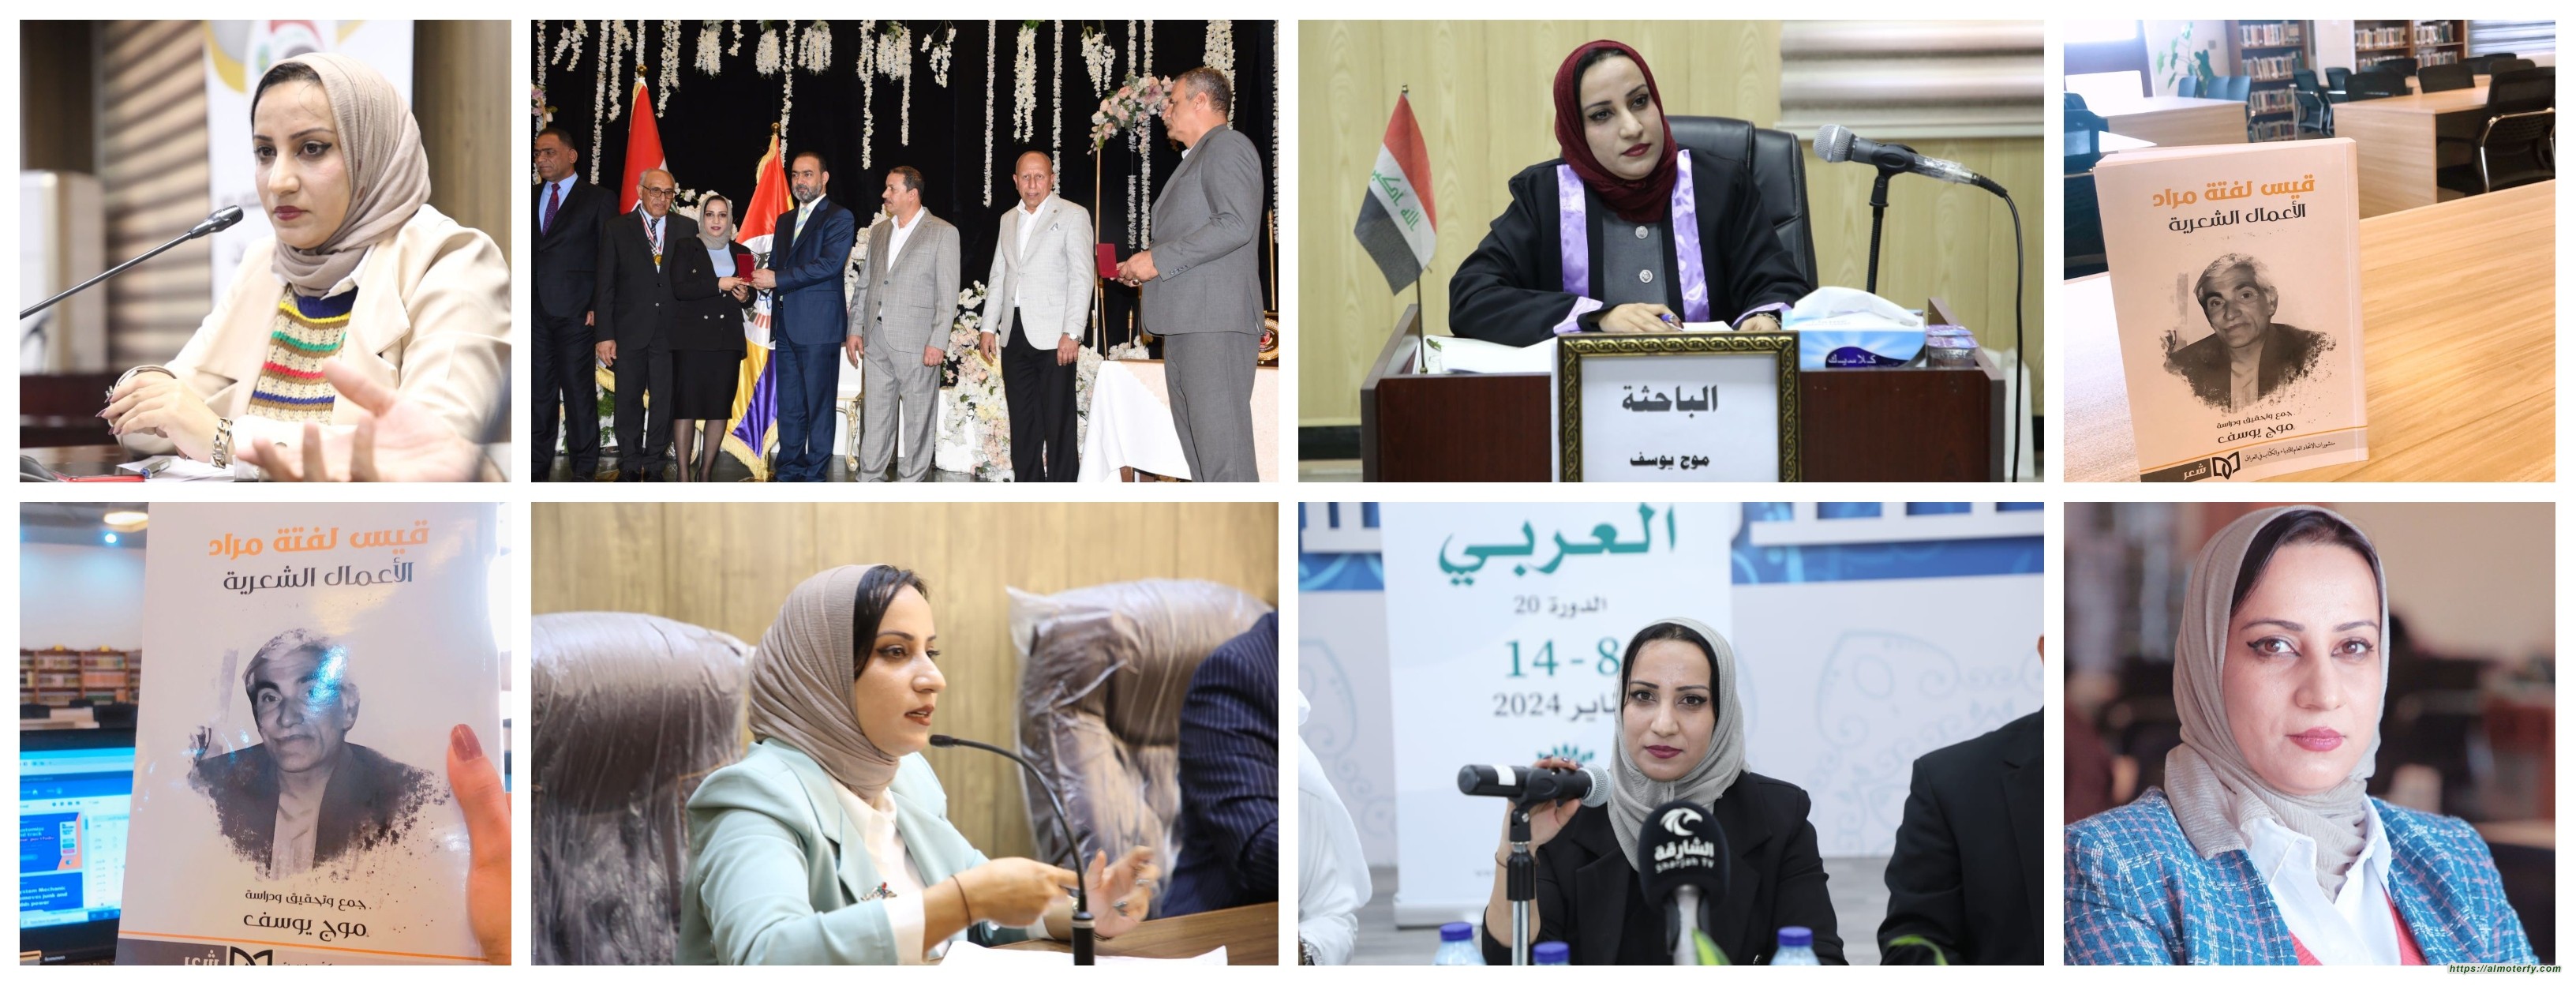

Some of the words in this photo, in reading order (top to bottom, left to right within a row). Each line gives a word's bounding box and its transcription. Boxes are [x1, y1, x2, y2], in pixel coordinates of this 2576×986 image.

[2204, 180, 2252, 201] لفتة
[2260, 174, 2315, 199] قيس
[2152, 189, 2197, 209] مراد
[2169, 209, 2240, 234] الشعرية
[2245, 201, 2306, 223] الأعمال
[1828, 354, 1877, 366] كلاسيك
[1622, 384, 1718, 418] الباحثة
[2216, 420, 2241, 429] ودراسة
[2243, 414, 2273, 424] وتحقيق
[2218, 429, 2261, 443] يوسف
[2266, 423, 2293, 438] موج
[1630, 452, 1674, 470] يوسف
[1680, 455, 1710, 470] موج
[2183, 463, 2207, 481] شعر
[209, 533, 263, 560] مراد
[273, 526, 339, 553] لفتة
[350, 519, 430, 554] قيس
[1438, 501, 1677, 586] العربي
[223, 565, 316, 594] الشعرية
[324, 557, 414, 587] الأعمال
[1513, 594, 1541, 615] 20
[1548, 595, 1608, 619] الدورة
[1504, 638, 1560, 678] 14
[1596, 636, 1620, 675] 8
[1492, 692, 1561, 717] 2024
[1654, 837, 1714, 861] الشارقة
[245, 890, 283, 902] ودراسة
[286, 892, 335, 907] وتحقيق
[243, 912, 313, 935] يوسف
[319, 920, 367, 942] موج
